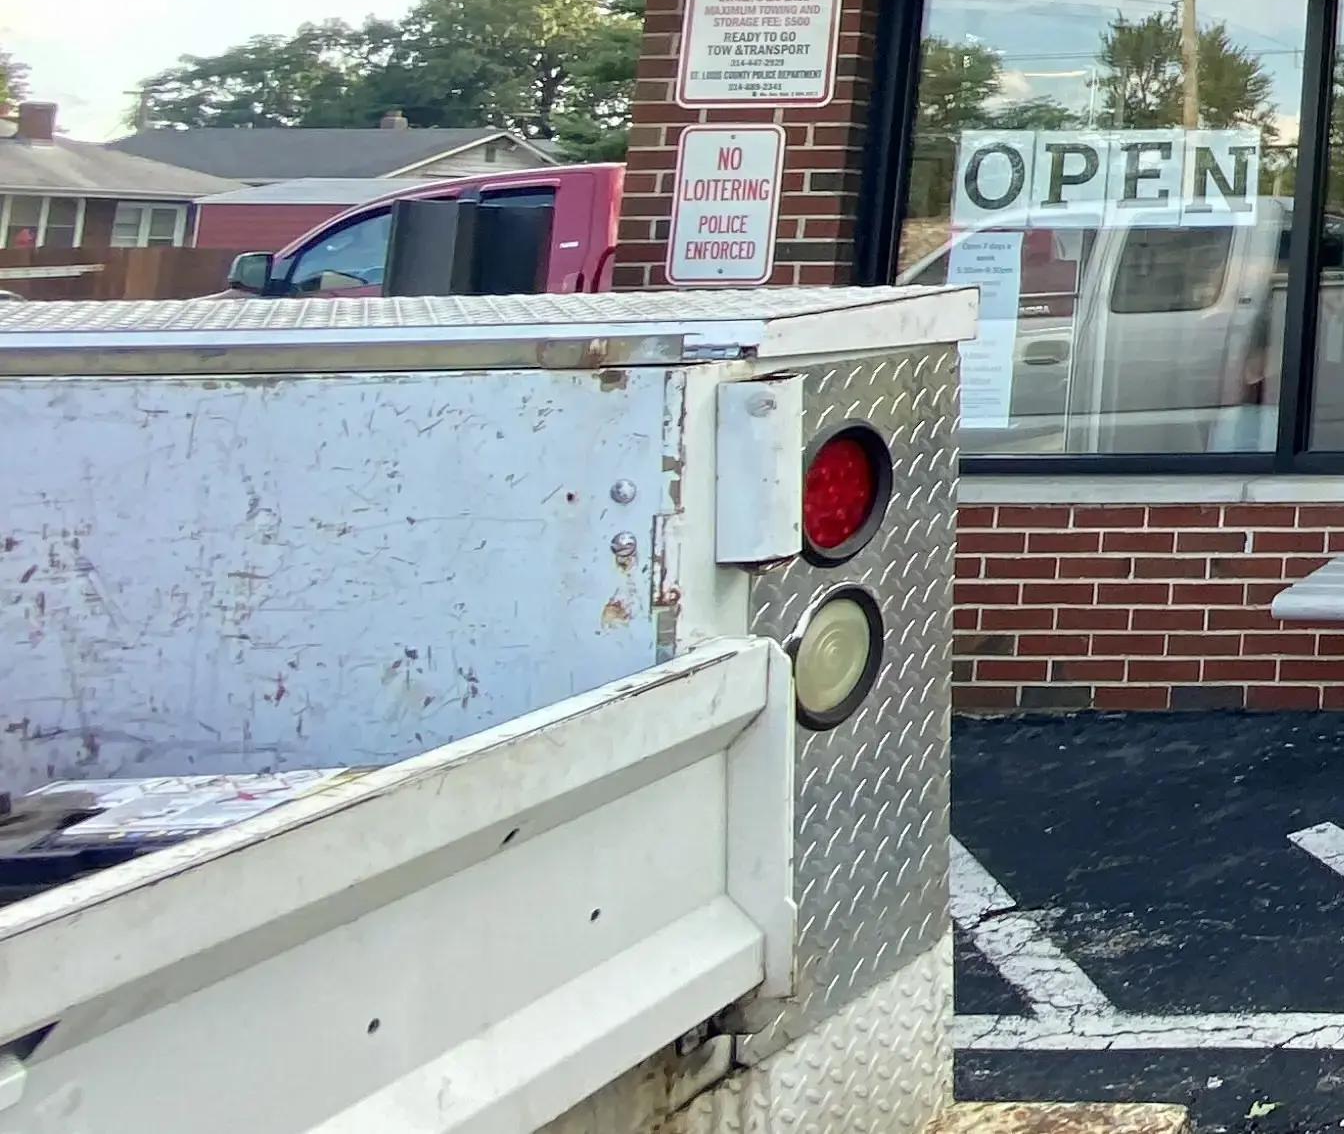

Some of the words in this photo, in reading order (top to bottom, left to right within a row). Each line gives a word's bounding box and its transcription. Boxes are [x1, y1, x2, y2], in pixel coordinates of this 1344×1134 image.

[704, 5, 757, 16] MAXIMUM
[759, 5, 797, 15] TOWING
[800, 4, 821, 15] AND
[713, 17, 758, 28] STORAGE
[723, 32, 761, 43] READY
[763, 31, 777, 42] TO
[780, 31, 797, 42] GO
[707, 45, 733, 56] TOW
[724, 70, 751, 80] COUNTY
[752, 70, 777, 79] POLICE
[777, 69, 823, 79] DEPARTMENT
[717, 147, 743, 171] NO
[964, 141, 1256, 214] OPEN
[683, 179, 770, 201] LOITERING
[698, 215, 749, 234] POLICE
[685, 241, 756, 260] ENFORCED
